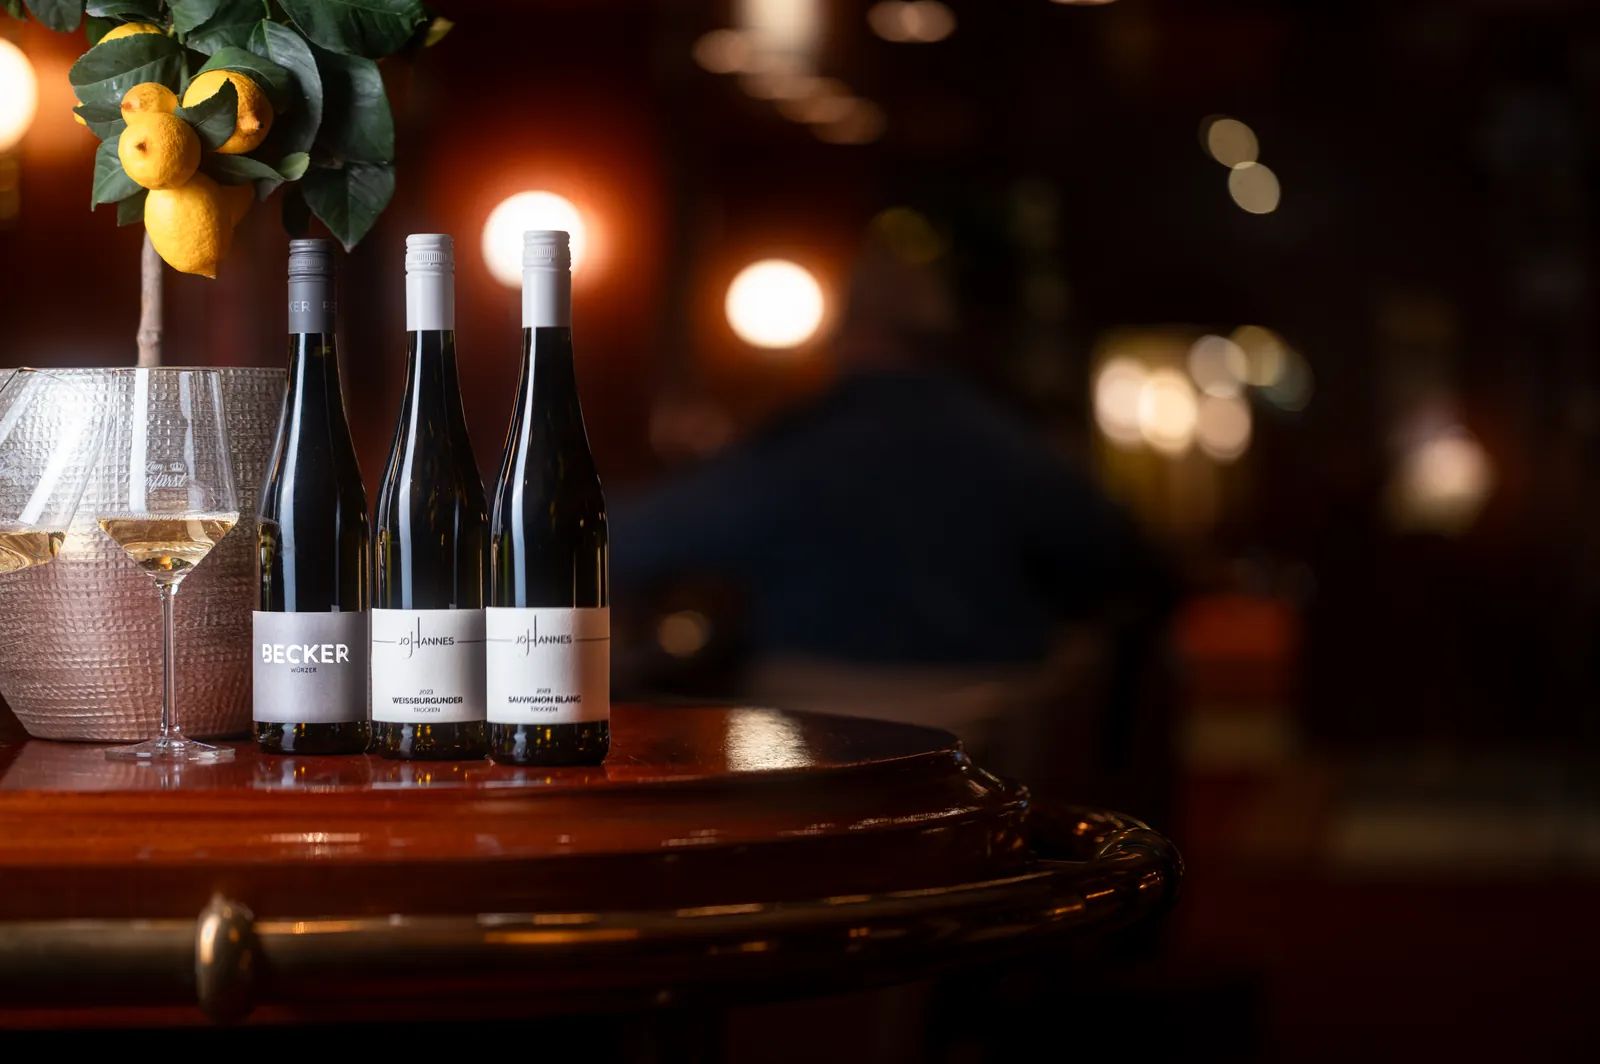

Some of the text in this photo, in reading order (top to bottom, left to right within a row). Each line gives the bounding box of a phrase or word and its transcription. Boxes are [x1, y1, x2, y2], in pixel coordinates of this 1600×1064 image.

[289, 300, 312, 312] KER
[398, 616, 455, 659] JOHANNES
[515, 614, 573, 656] JOHANNES
[262, 643, 350, 664] BECKER
[290, 666, 318, 674] WÜRZER
[392, 696, 464, 704] WEISSBURGUNDER
[508, 695, 582, 704] SAUVIGNON BLANC
